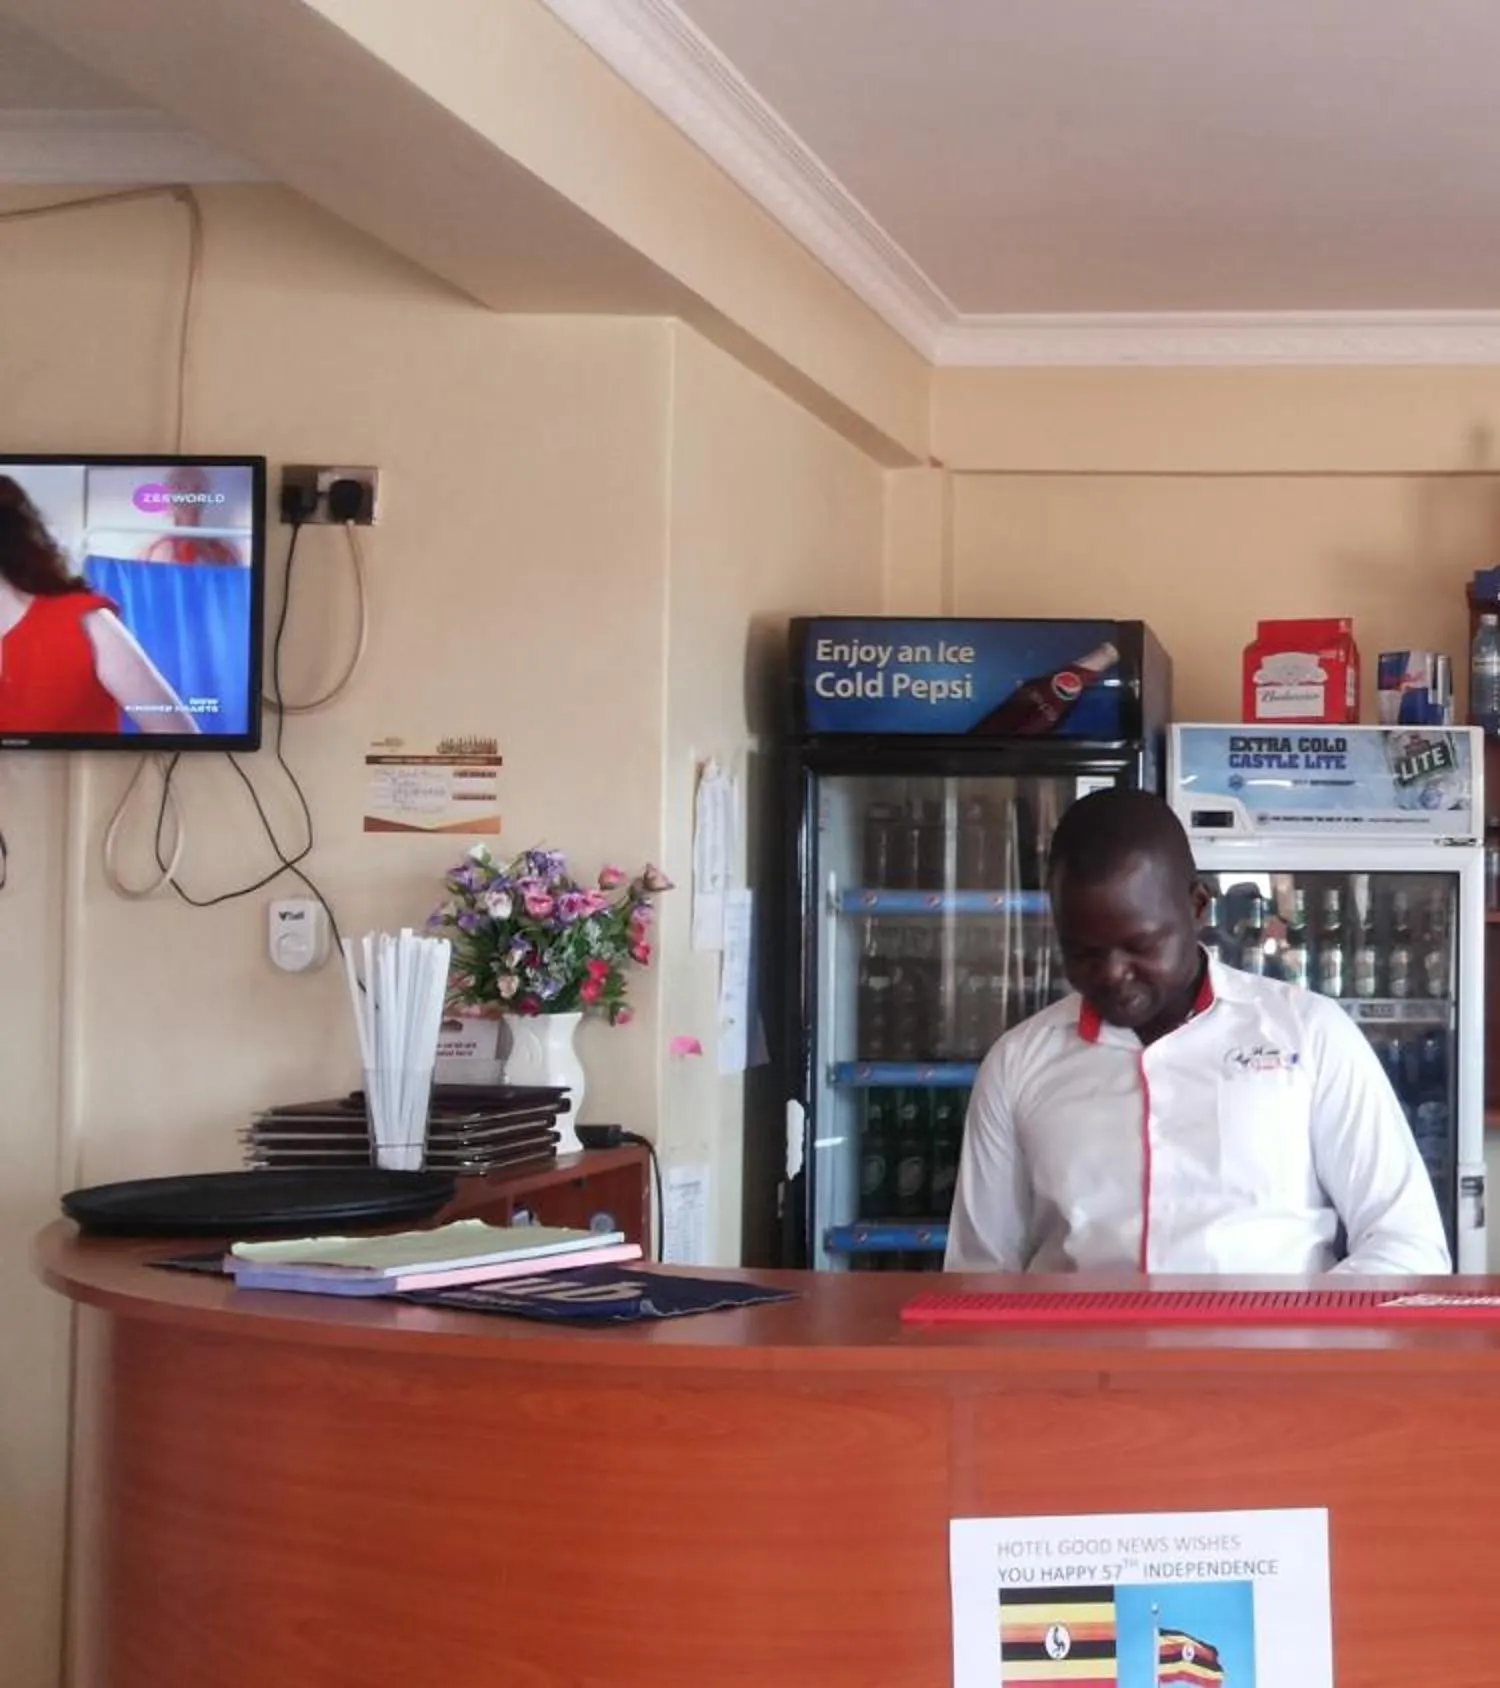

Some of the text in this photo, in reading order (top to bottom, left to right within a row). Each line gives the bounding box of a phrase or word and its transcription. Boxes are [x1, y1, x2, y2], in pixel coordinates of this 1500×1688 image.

[816, 639, 975, 667] Enjoy an Ice
[815, 672, 973, 704] Cold Pepsi
[1229, 736, 1347, 753] EXTRA COLD
[1229, 754, 1347, 770] CASTLE LITE
[1401, 746, 1447, 780] LITE
[997, 1533, 1242, 1558] HOTEL GOOD NEWS WISHES
[998, 1566, 1035, 1583] YOU
[1041, 1564, 1096, 1582] HAPPY
[1143, 1559, 1279, 1578] INDEPENDENCE
